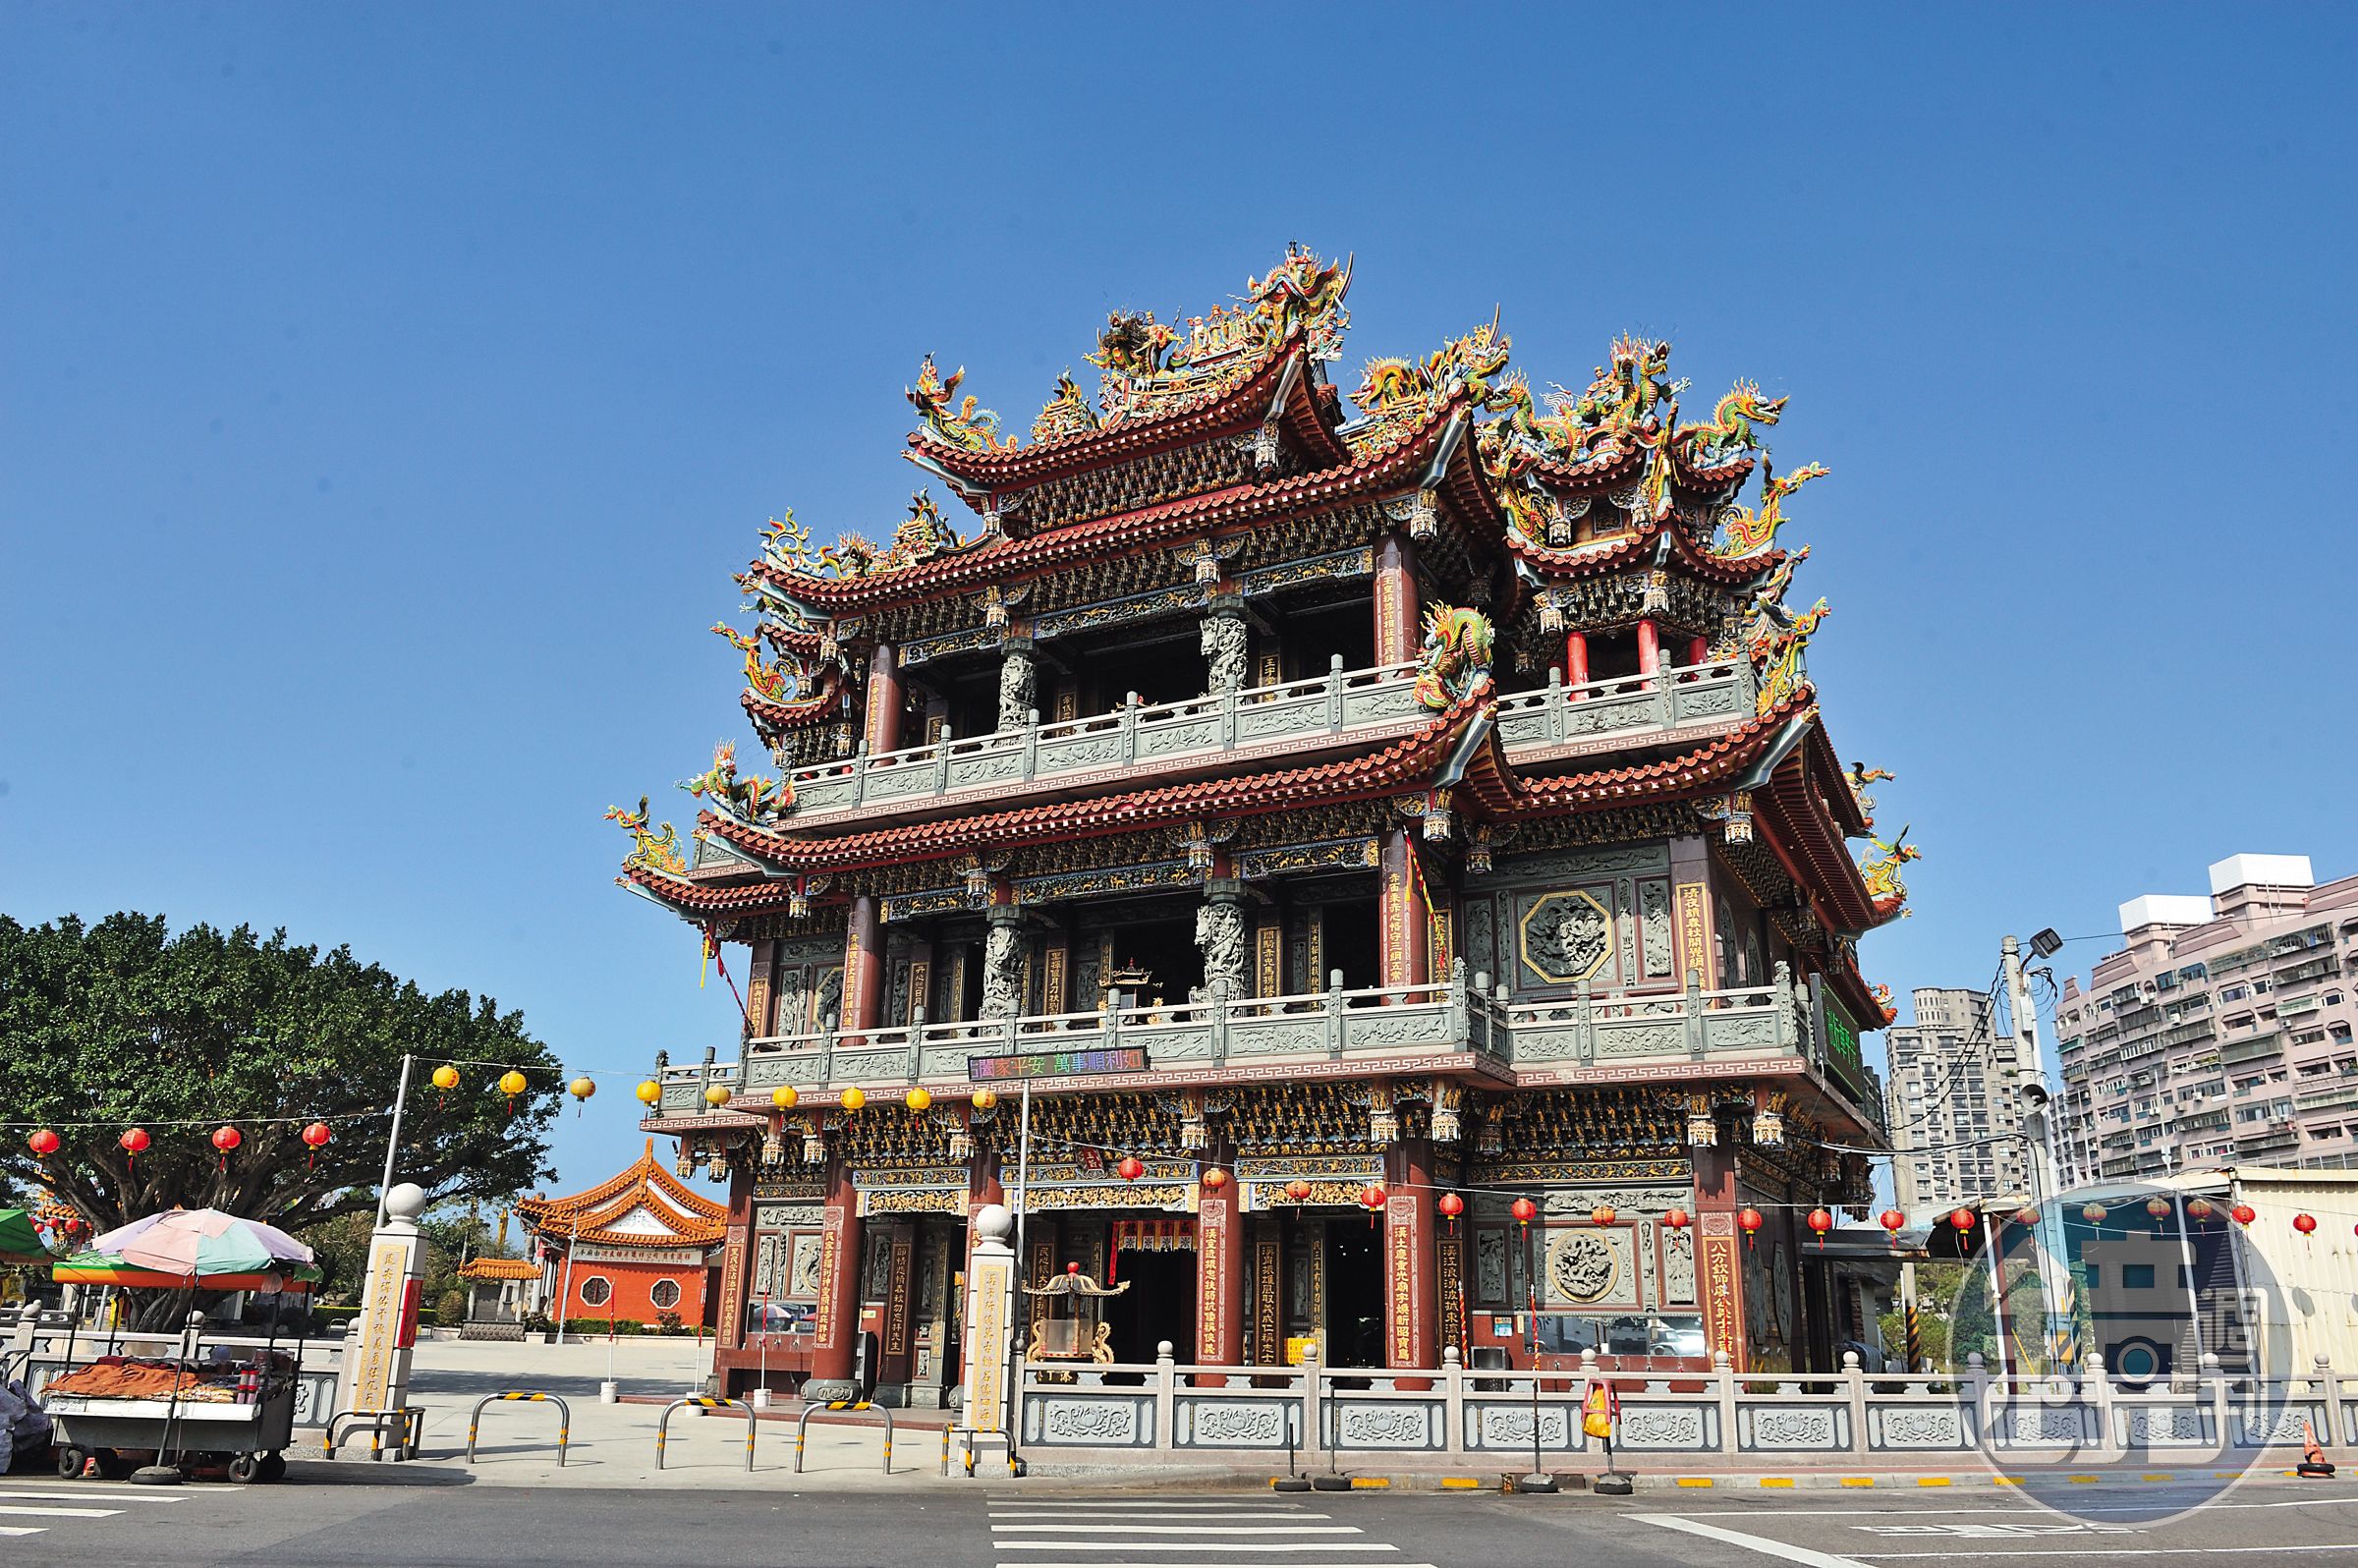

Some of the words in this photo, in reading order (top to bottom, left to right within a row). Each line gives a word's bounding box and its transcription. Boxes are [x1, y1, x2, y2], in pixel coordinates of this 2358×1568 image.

[1053, 1049, 1141, 1073] 萬事順利如
